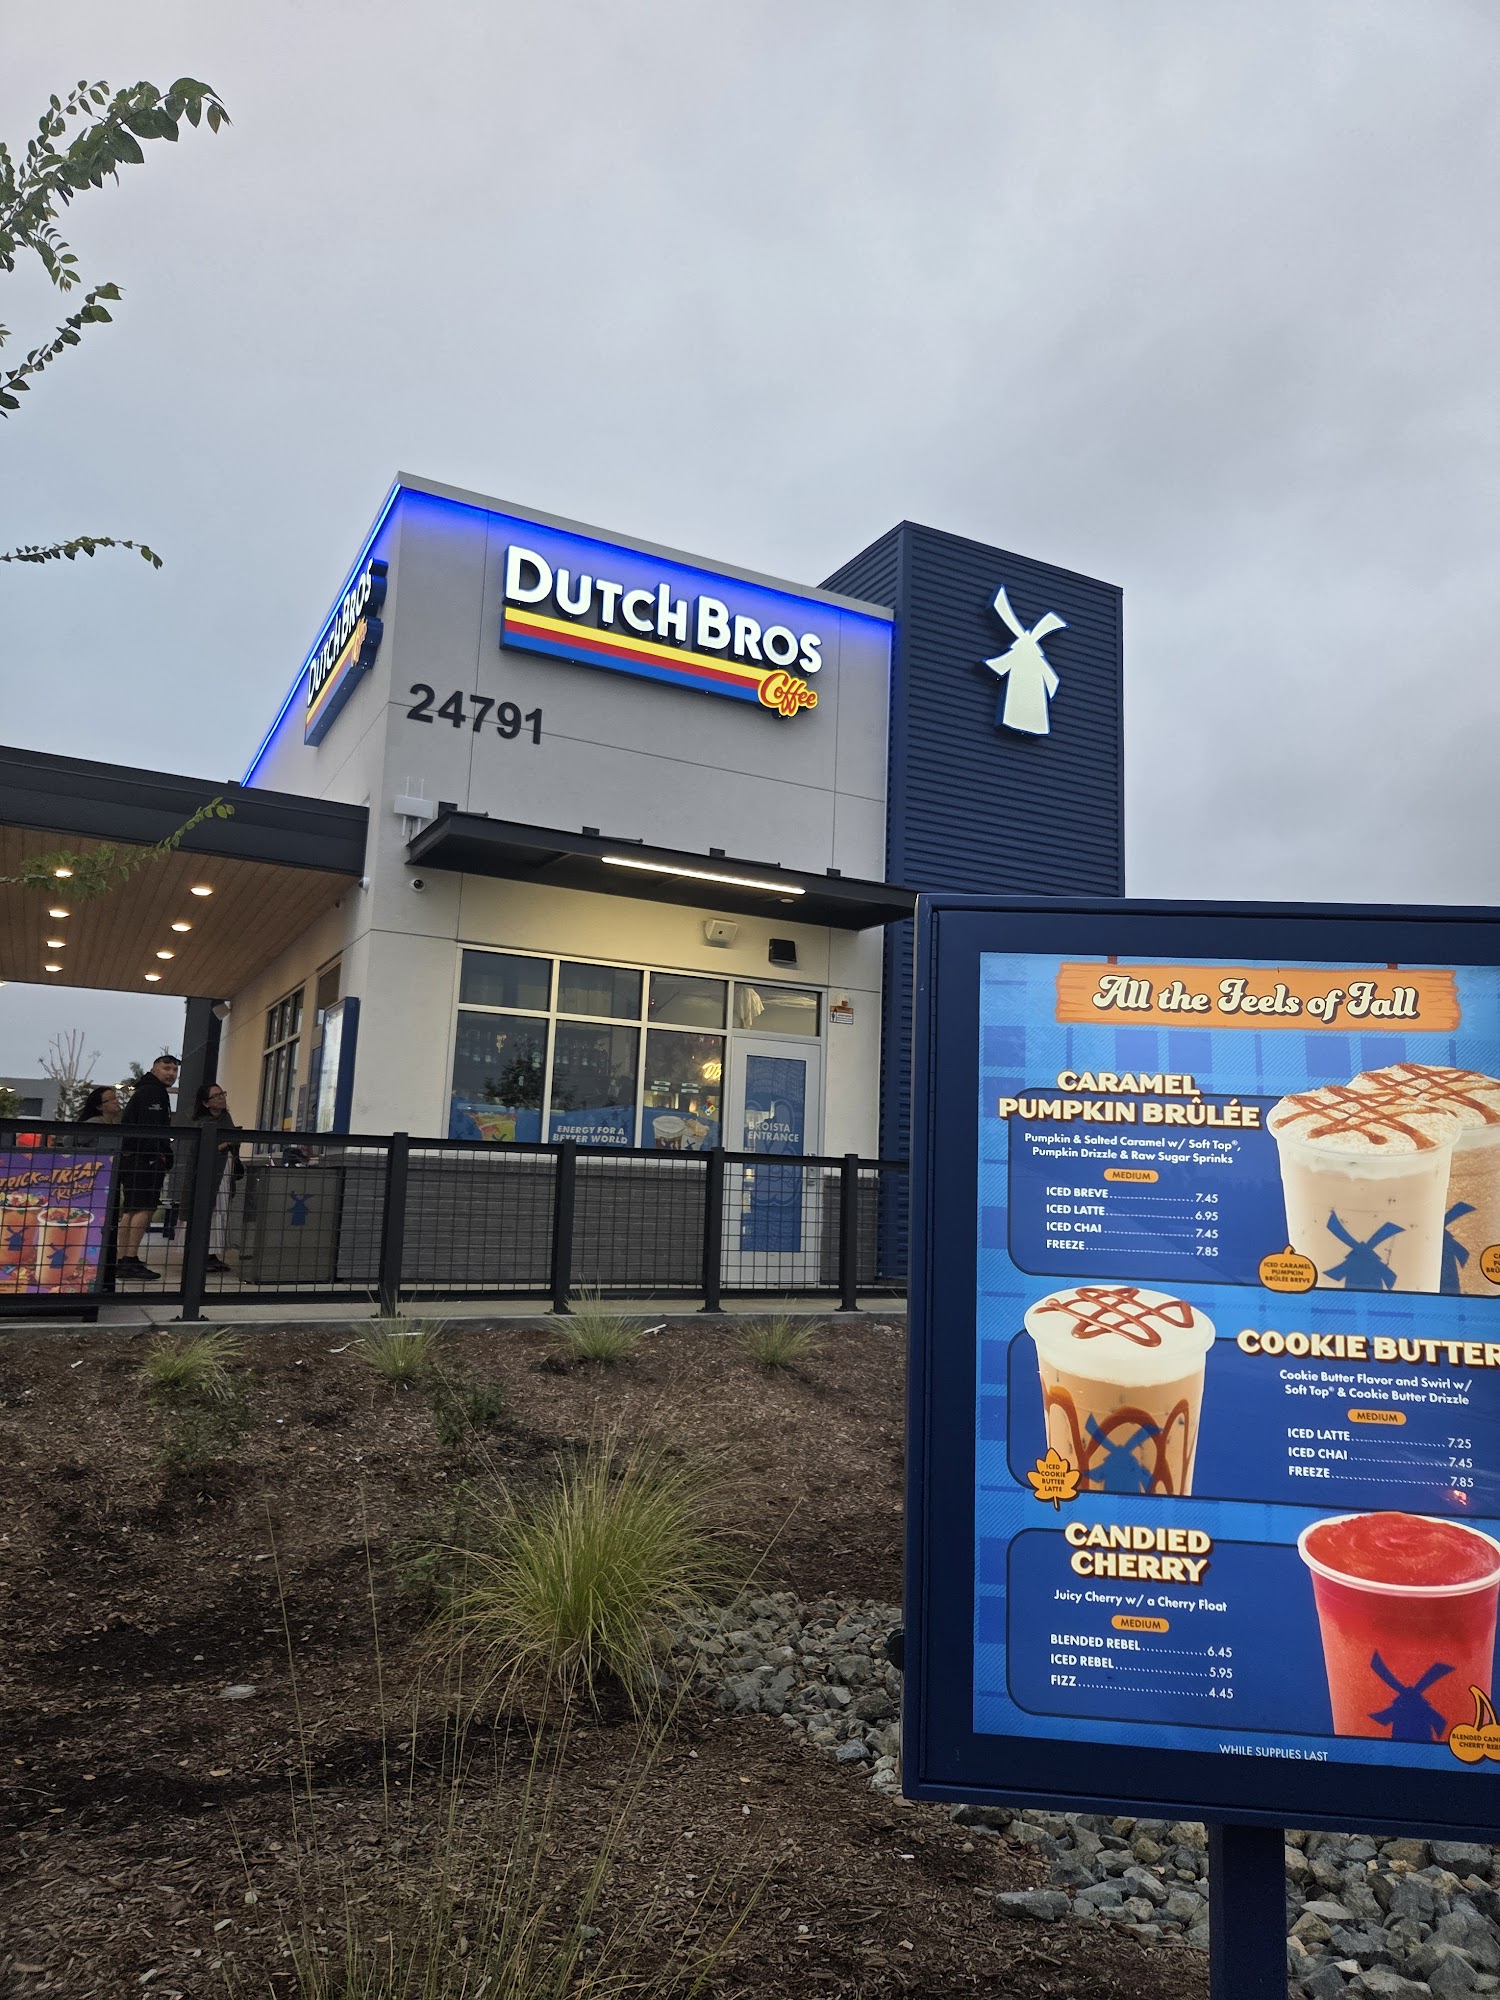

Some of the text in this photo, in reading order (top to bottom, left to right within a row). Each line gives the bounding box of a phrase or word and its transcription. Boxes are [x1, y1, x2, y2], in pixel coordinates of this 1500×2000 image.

[341, 558, 373, 646] BROS
[695, 594, 822, 676] BROS
[761, 671, 817, 717] Coffee
[407, 683, 544, 745] 24791
[1092, 975, 1419, 1022] All the Feels of Fall
[1056, 1071, 1200, 1096] CARAMEL
[999, 1098, 1260, 1127] PUMPKIN BRÛLÉE
[557, 1125, 595, 1134] ENERGY
[748, 1132, 799, 1142] ENTRANCE
[749, 1122, 790, 1132] BROISTA
[591, 1135, 628, 1144] WORLD
[1024, 1133, 1070, 1147] Pumpkin
[1073, 1135, 1082, 1144] &
[1084, 1134, 1117, 1146] Salted
[1120, 1136, 1165, 1148] Caramel
[1168, 1137, 1184, 1150] w/
[1188, 1139, 1210, 1150] Soft
[1032, 1147, 1233, 1164] Pumpkin Drizzle & Raw Sugar Sprinks
[1112, 1171, 1151, 1180] MEDIUM
[1046, 1187, 1218, 1203] ICED BREVE 7.45
[1046, 1204, 1218, 1221] ICED LATTE 6.95
[1046, 1222, 1218, 1239] ICED CHAI 7.45
[1046, 1240, 1218, 1256] FREEZE 7.85
[1237, 1329, 1500, 1365] COOKIE BUTTER
[1279, 1369, 1472, 1392] Cookie Butter Flavor and Swirl w/
[1284, 1384, 1306, 1396] Soft
[1337, 1388, 1346, 1398] &
[1349, 1388, 1388, 1401] Cookie
[1392, 1390, 1427, 1403] Butter
[1429, 1393, 1469, 1405] Drizzle
[1357, 1412, 1399, 1423] MEDIUM
[1288, 1428, 1472, 1449] ICED LATTE 7.25
[1288, 1447, 1473, 1469] ICED CHAI 7.45
[1288, 1466, 1474, 1488] FREEZE 7.85
[1065, 1522, 1211, 1554] CANDIED
[1071, 1551, 1208, 1583] CHERRY
[1054, 1589, 1227, 1612] Juicy Cherry w/ a Cherry Float
[1120, 1619, 1162, 1629] MEDIUM
[1051, 1634, 1232, 1659] BLENDED REBEL 6.45
[1051, 1654, 1233, 1679] ICED REBEL 5.95
[1051, 1675, 1233, 1700] FIZZ 4.45
[1219, 1743, 1328, 1762] WHILE SUPPLIES LAST
